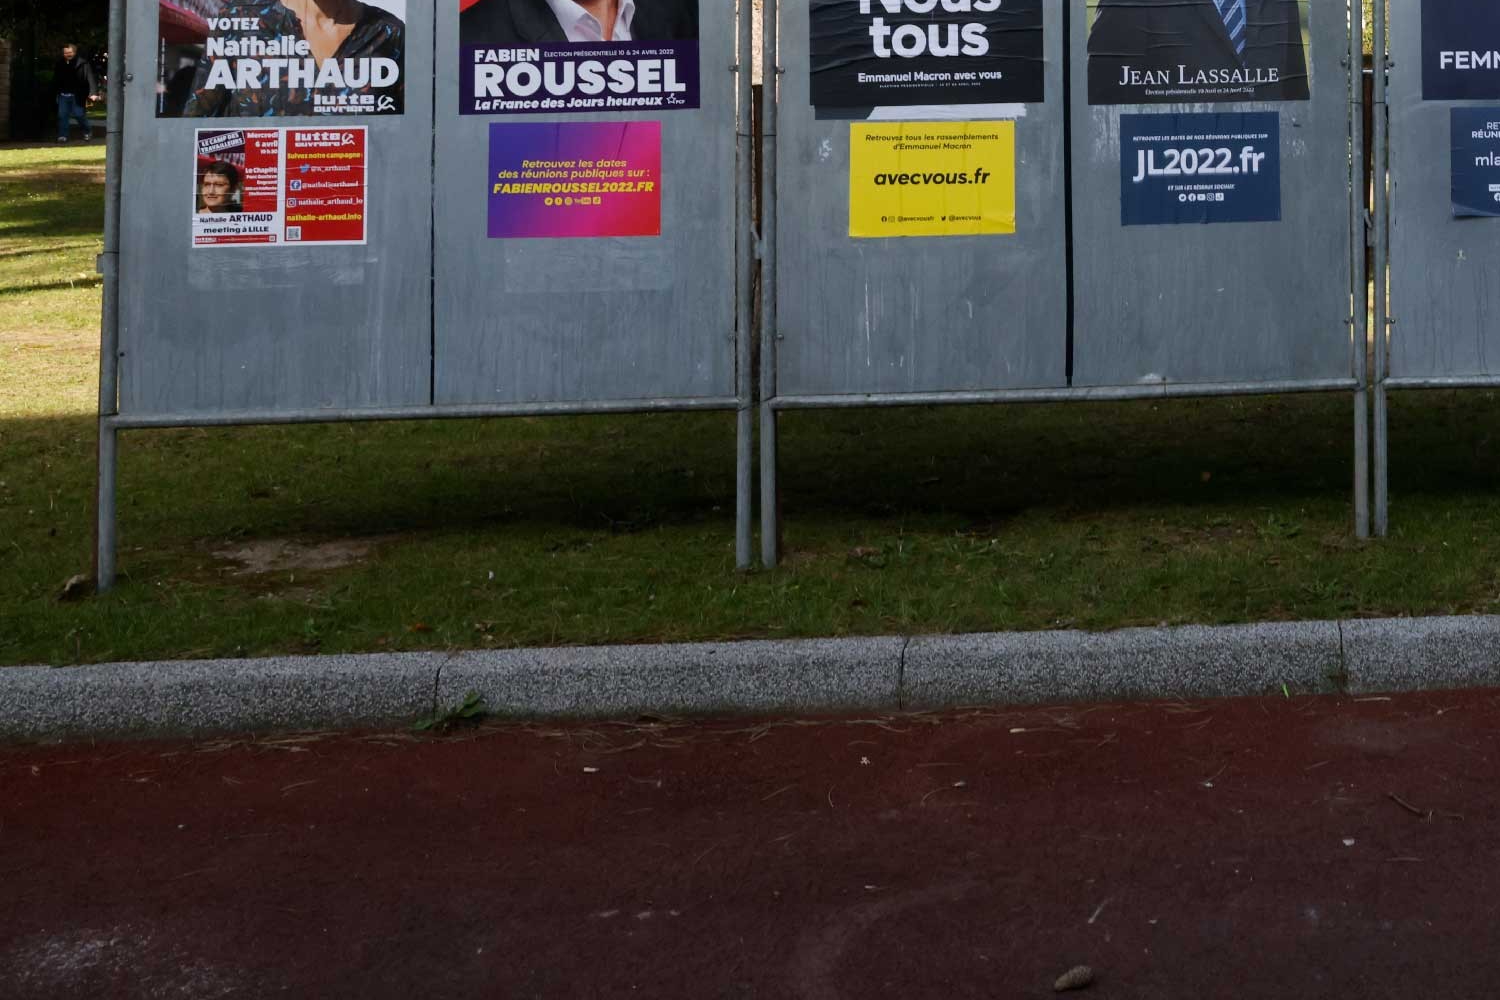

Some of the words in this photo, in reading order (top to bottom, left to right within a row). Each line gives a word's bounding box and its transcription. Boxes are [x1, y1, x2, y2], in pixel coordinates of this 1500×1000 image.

[208, 17, 259, 31] VOTEZ
[868, 16, 990, 58] tous
[206, 35, 310, 57] Nathalie
[474, 48, 540, 63] FABIEN
[203, 57, 400, 90] ARTHAUD
[474, 58, 686, 98] ROUSSEL
[858, 72, 912, 83] Emmanuel
[914, 71, 951, 81] Macron
[954, 71, 976, 80] avec
[978, 71, 1002, 80] vous
[1119, 65, 1170, 86] JEAN
[1177, 64, 1279, 85] LASSALLE
[314, 94, 374, 105] lutte
[475, 99, 491, 111] La
[492, 98, 540, 110] France
[541, 97, 565, 108] des
[567, 97, 604, 108] Jours
[606, 95, 663, 107] heureux
[295, 132, 340, 141] lutte
[865, 134, 903, 142] Retrouvez
[936, 133, 999, 141] rassemblements
[326, 152, 360, 160] campagne
[522, 160, 575, 169] Retrouvez
[579, 159, 593, 168] les
[596, 159, 627, 168] dates
[1132, 145, 1265, 182] JL2022.fr
[498, 169, 518, 179] des
[521, 168, 568, 179] réunions
[570, 168, 624, 180] publiques
[627, 169, 645, 178] sur
[873, 168, 990, 186] avecvous.fr
[493, 181, 654, 194] FABIENROUSSEL2022.FR
[229, 214, 273, 222] ARTHAUD
[287, 213, 362, 221] nathalie-arthaud.info
